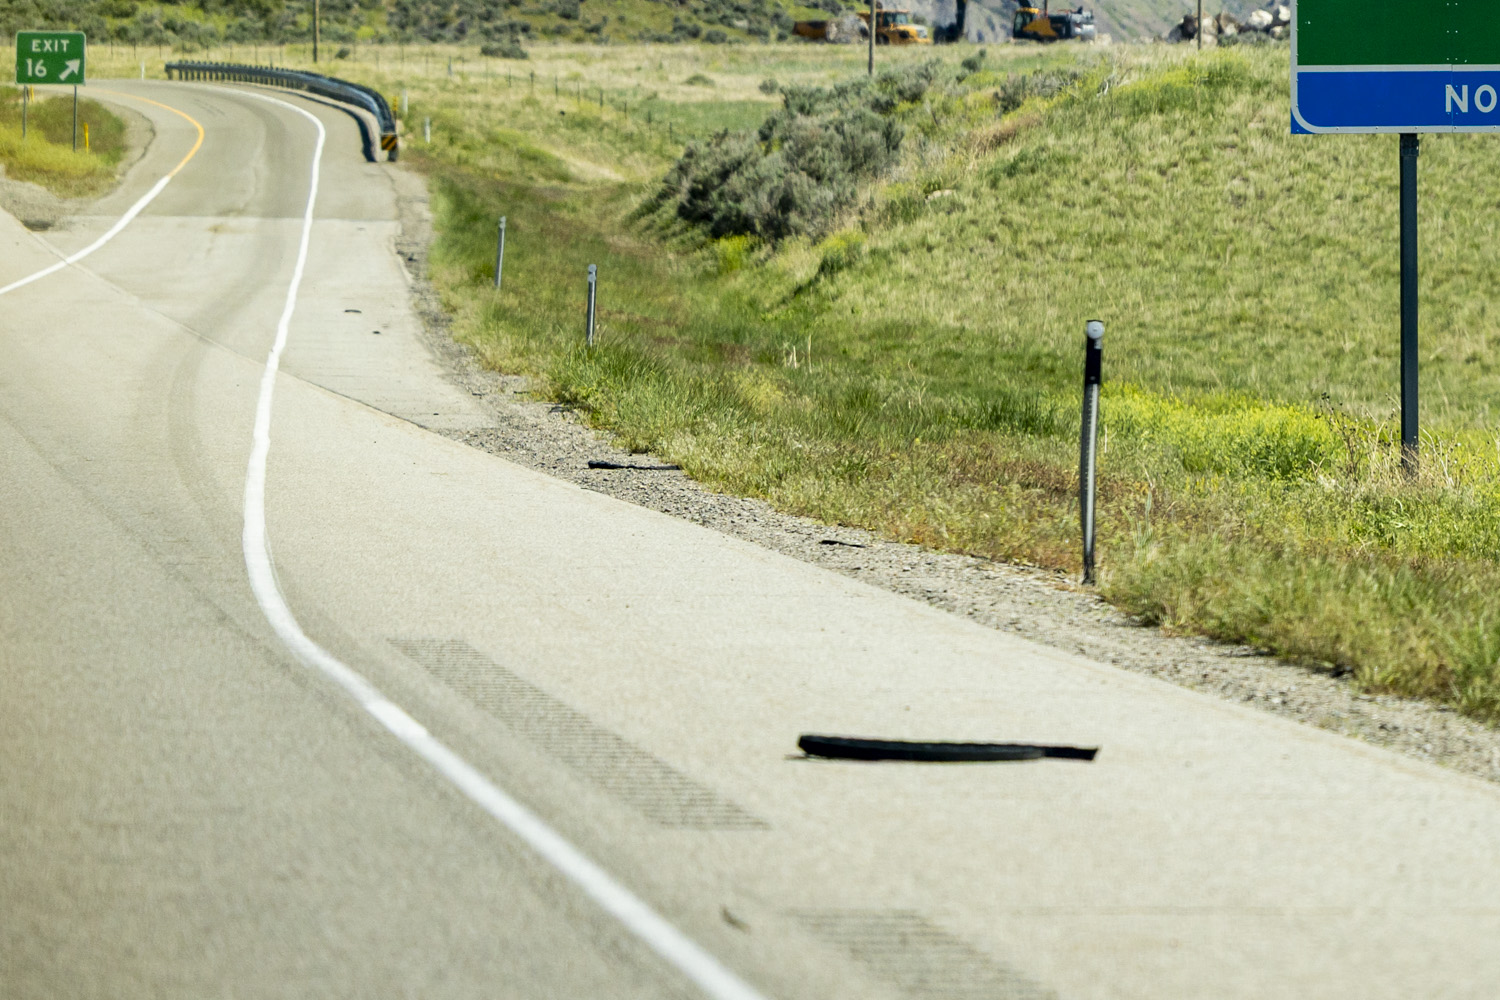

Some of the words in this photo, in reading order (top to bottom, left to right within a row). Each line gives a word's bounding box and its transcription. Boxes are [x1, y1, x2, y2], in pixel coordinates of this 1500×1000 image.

[31, 39, 70, 52] EXIT
[26, 58, 47, 78] 16
[1445, 84, 1498, 113] NO
